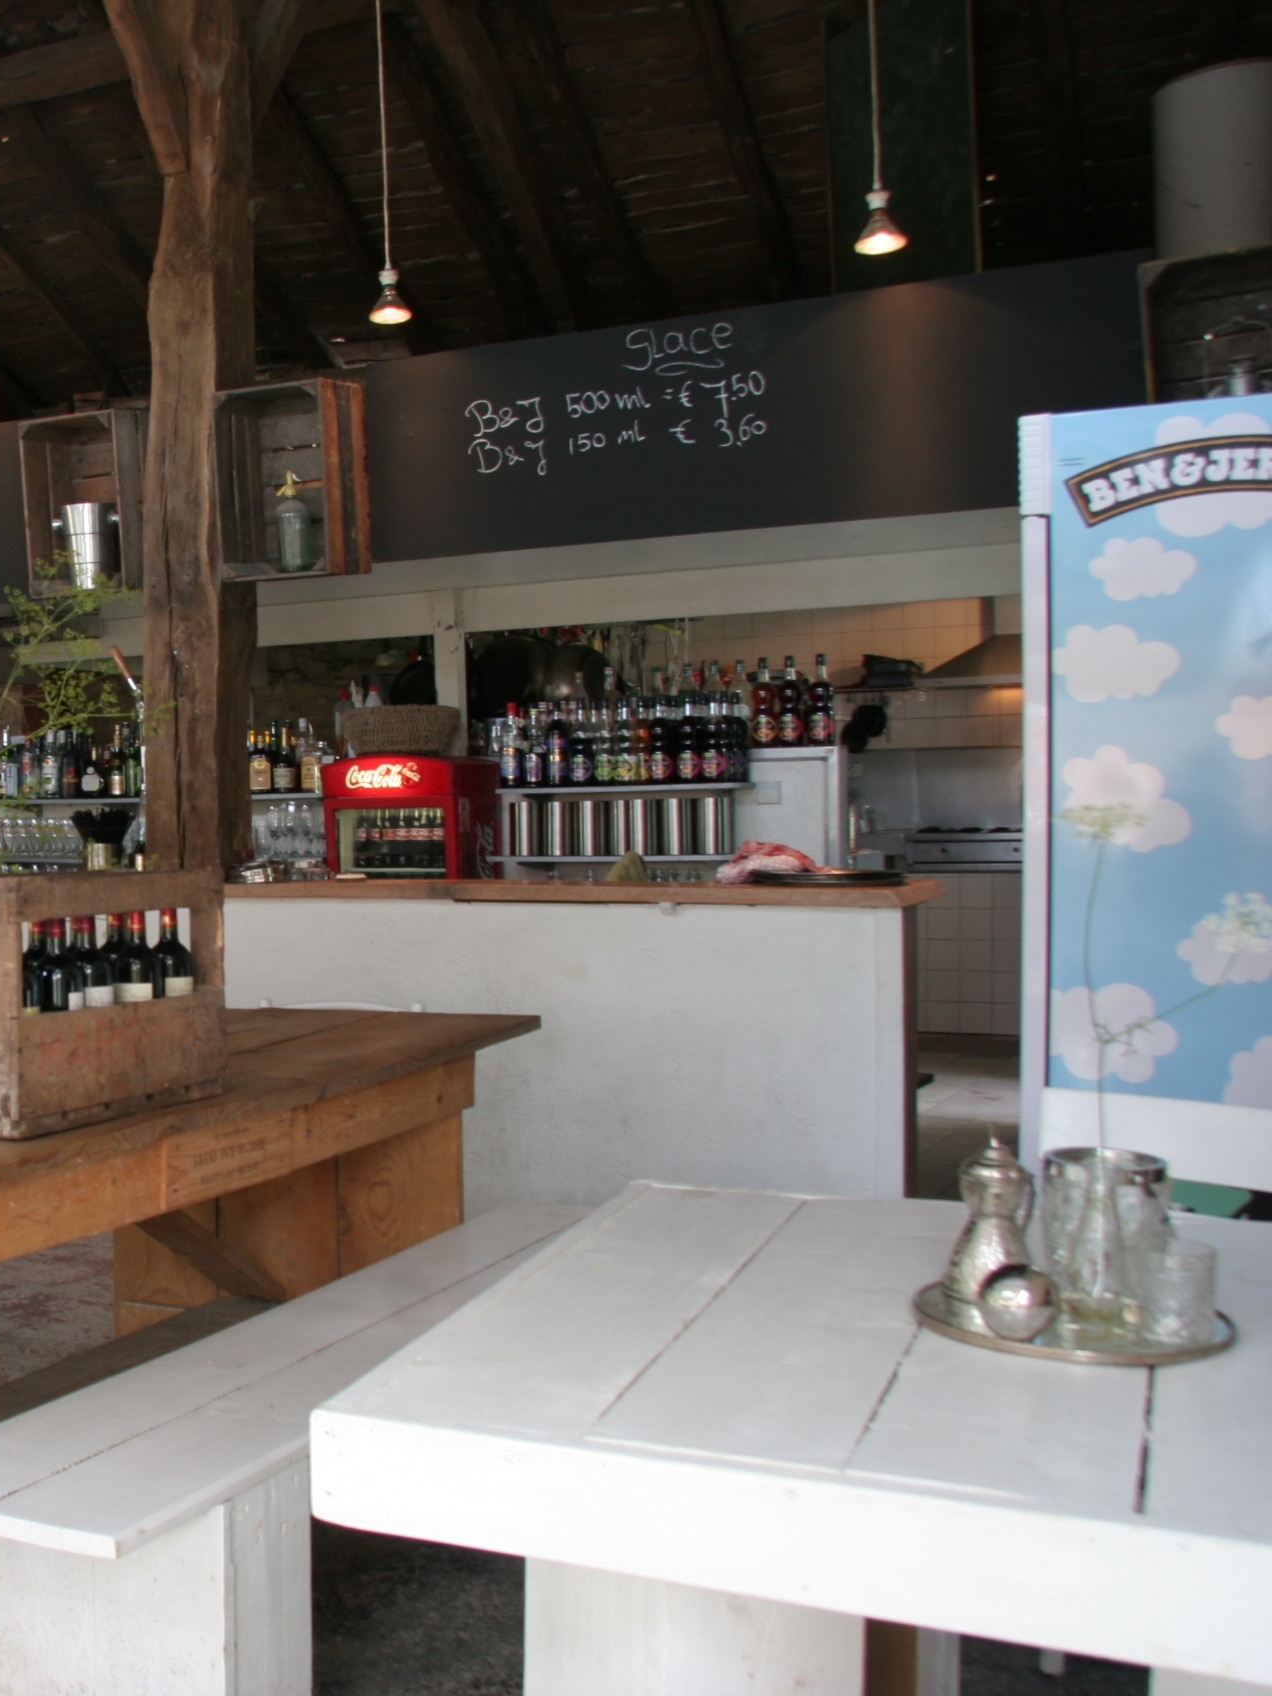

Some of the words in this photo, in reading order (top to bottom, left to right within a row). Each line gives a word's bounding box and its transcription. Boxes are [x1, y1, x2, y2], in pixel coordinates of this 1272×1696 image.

[566, 390, 610, 418] 500
[569, 432, 606, 455] 150
[714, 413, 767, 447] 3.60
[345, 763, 404, 789] Coca-Cola
